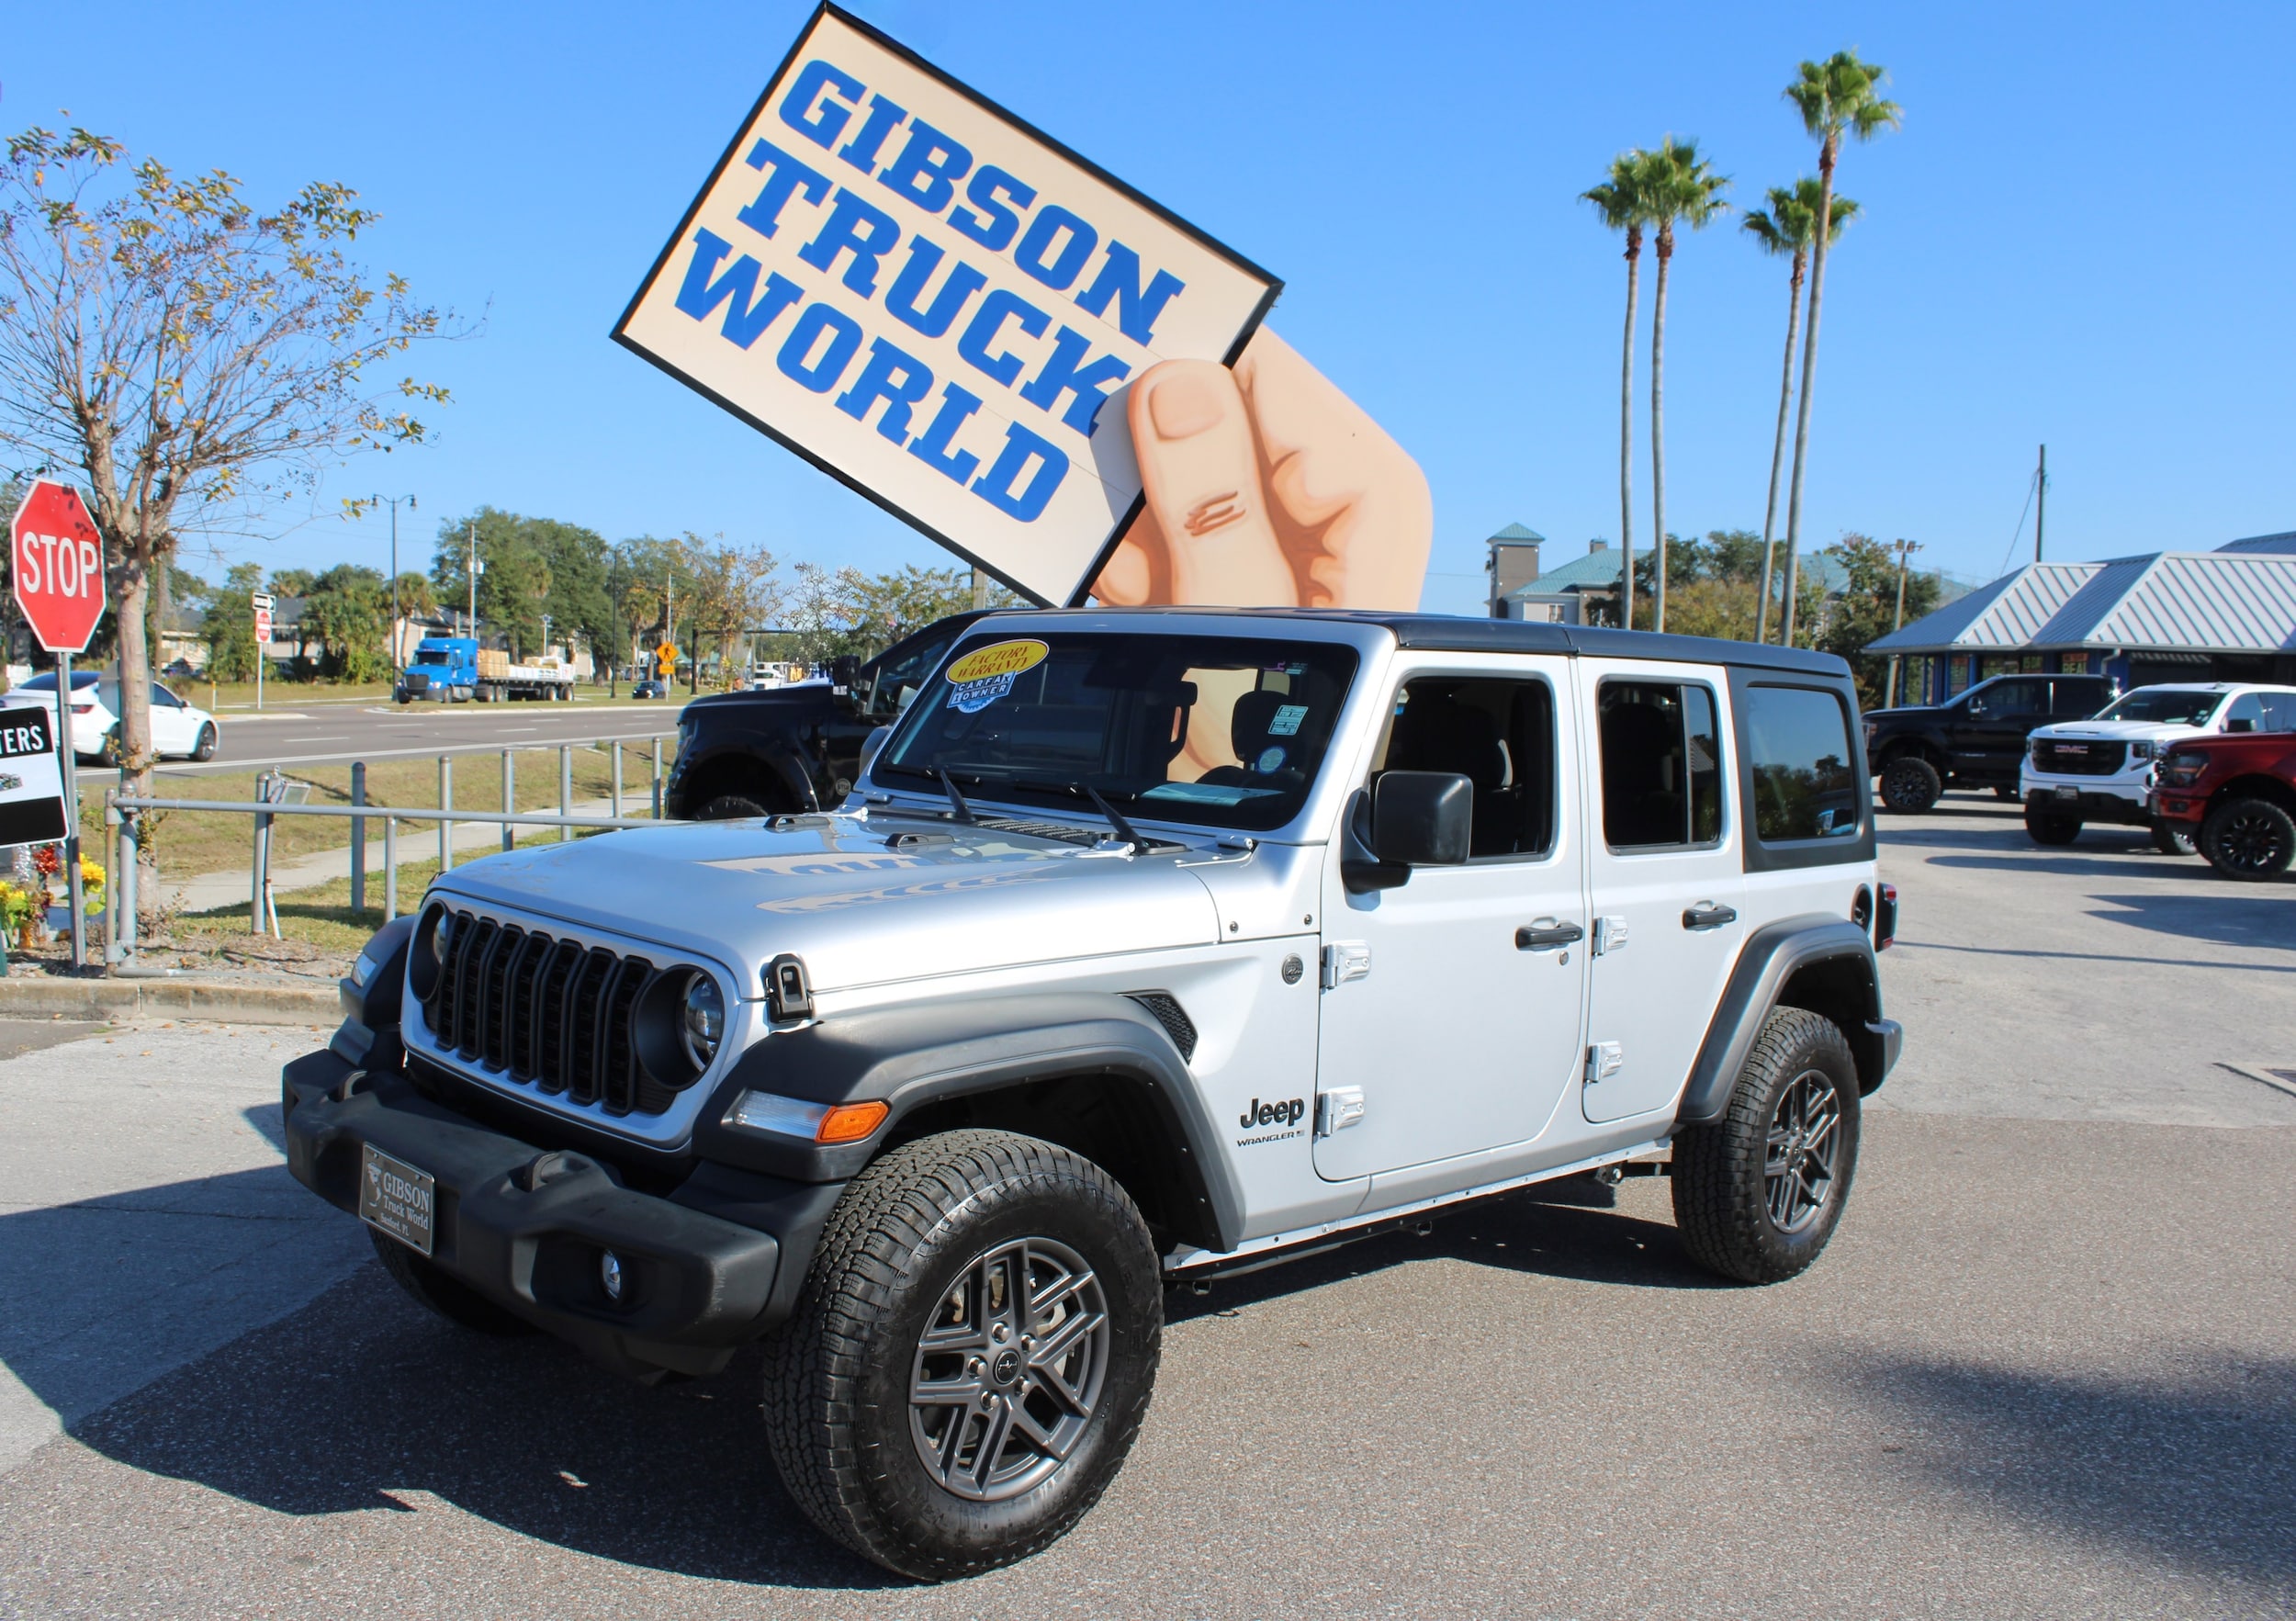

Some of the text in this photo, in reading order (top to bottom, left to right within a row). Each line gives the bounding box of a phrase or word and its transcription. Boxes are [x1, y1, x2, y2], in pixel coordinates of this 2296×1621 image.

[778, 60, 1186, 346] GIBSON
[736, 138, 1131, 438] TRUCK
[675, 227, 1070, 523] WORLD
[21, 531, 98, 599] STOP
[957, 657, 1028, 679] WARRANTY
[968, 646, 1029, 667] FACTORY
[958, 674, 1012, 692] CARFAX
[962, 683, 1007, 701] OWNER
[2054, 744, 2088, 754] GMC
[1240, 1098, 1305, 1129] Jeep
[1236, 1131, 1294, 1147] WRANGLER
[383, 1171, 430, 1212] GIBSON
[384, 1195, 429, 1231] Truck World
